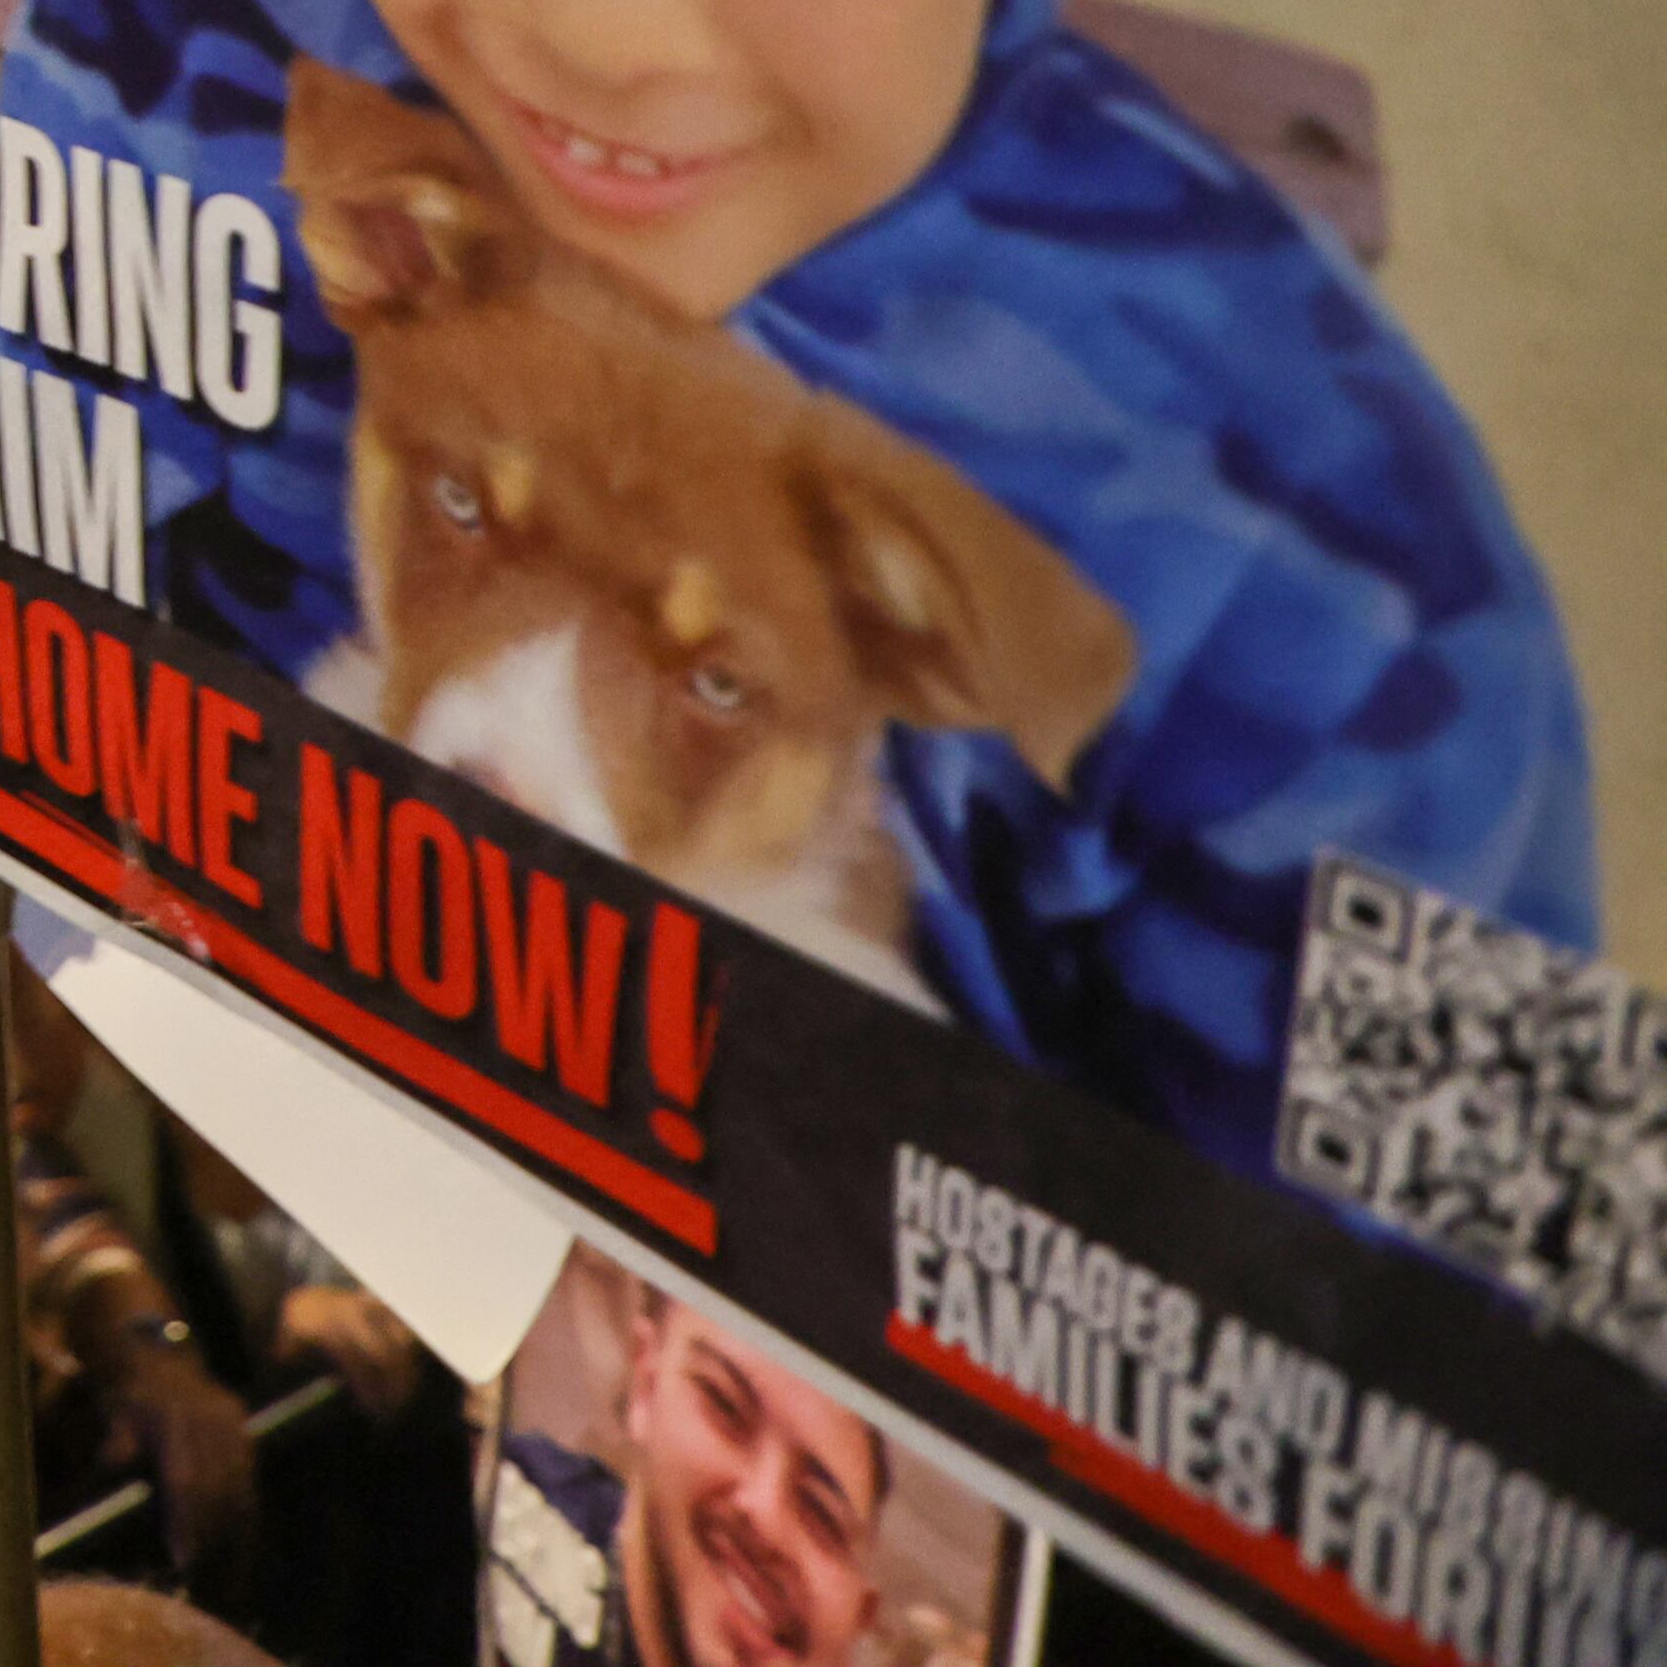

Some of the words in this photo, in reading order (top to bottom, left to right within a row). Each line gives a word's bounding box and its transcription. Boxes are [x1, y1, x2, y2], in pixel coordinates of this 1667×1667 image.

[299, 741, 705, 1163] NOW!
[895, 1140, 1199, 1374] HOSTAGES
[1203, 1316, 1349, 1454] AND
[897, 1224, 1278, 1536] FAMILIES
